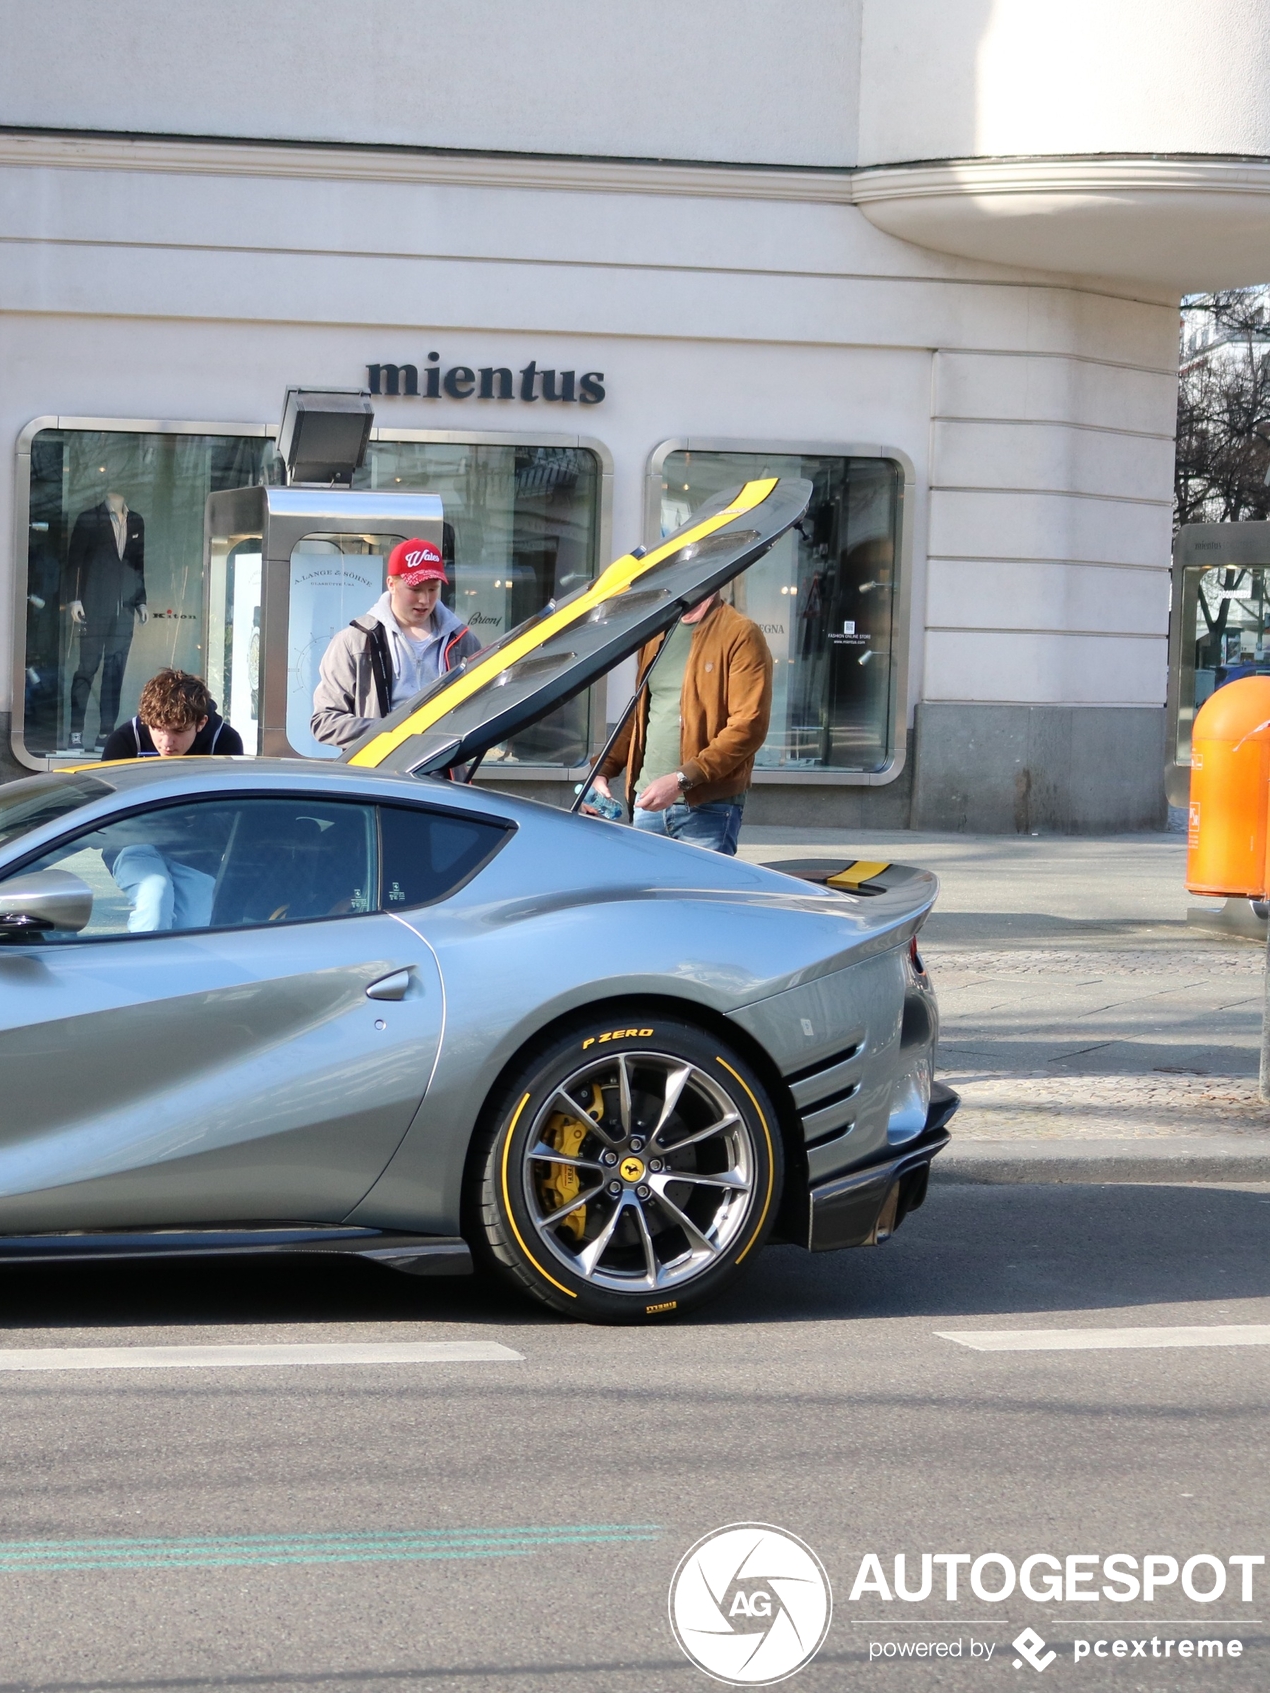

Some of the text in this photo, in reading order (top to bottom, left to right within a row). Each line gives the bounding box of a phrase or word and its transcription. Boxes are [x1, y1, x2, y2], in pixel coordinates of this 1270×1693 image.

[366, 351, 607, 404] mientus
[405, 548, 440, 567] Wales
[343, 571, 372, 587] SÖHNE
[153, 609, 196, 619] Kiton
[582, 1028, 654, 1050] P ZERO
